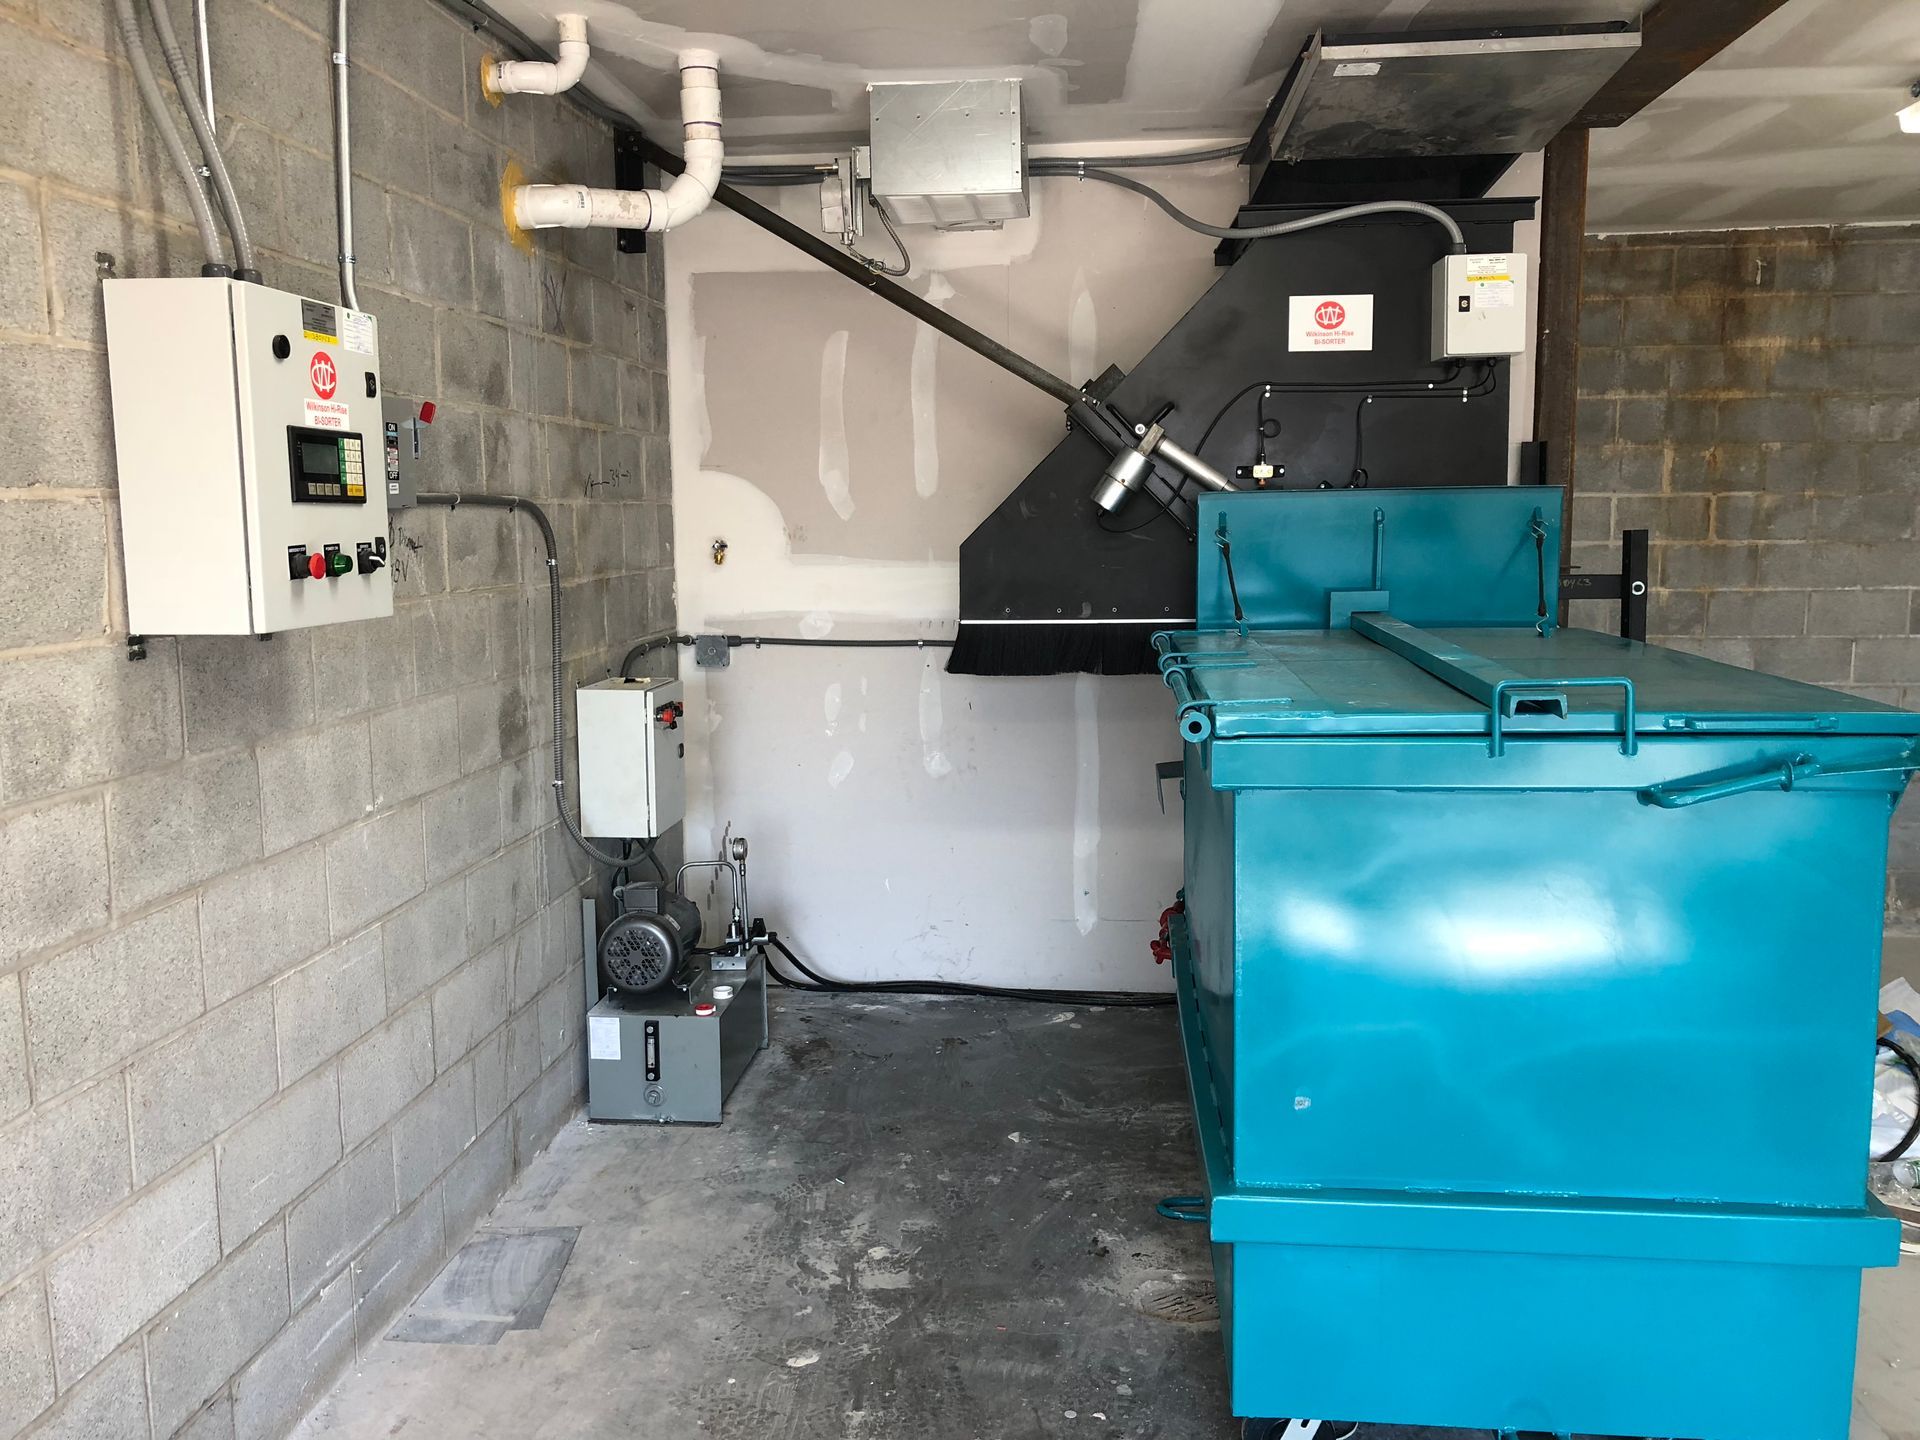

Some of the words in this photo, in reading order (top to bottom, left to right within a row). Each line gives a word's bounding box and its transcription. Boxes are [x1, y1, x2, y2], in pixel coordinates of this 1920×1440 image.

[306, 400, 331, 413] Wilkinson
[331, 404, 348, 415] Hi-Rise
[314, 415, 342, 428] BI-SORTER
[387, 423, 396, 431] ON
[388, 471, 398, 479] OFF
